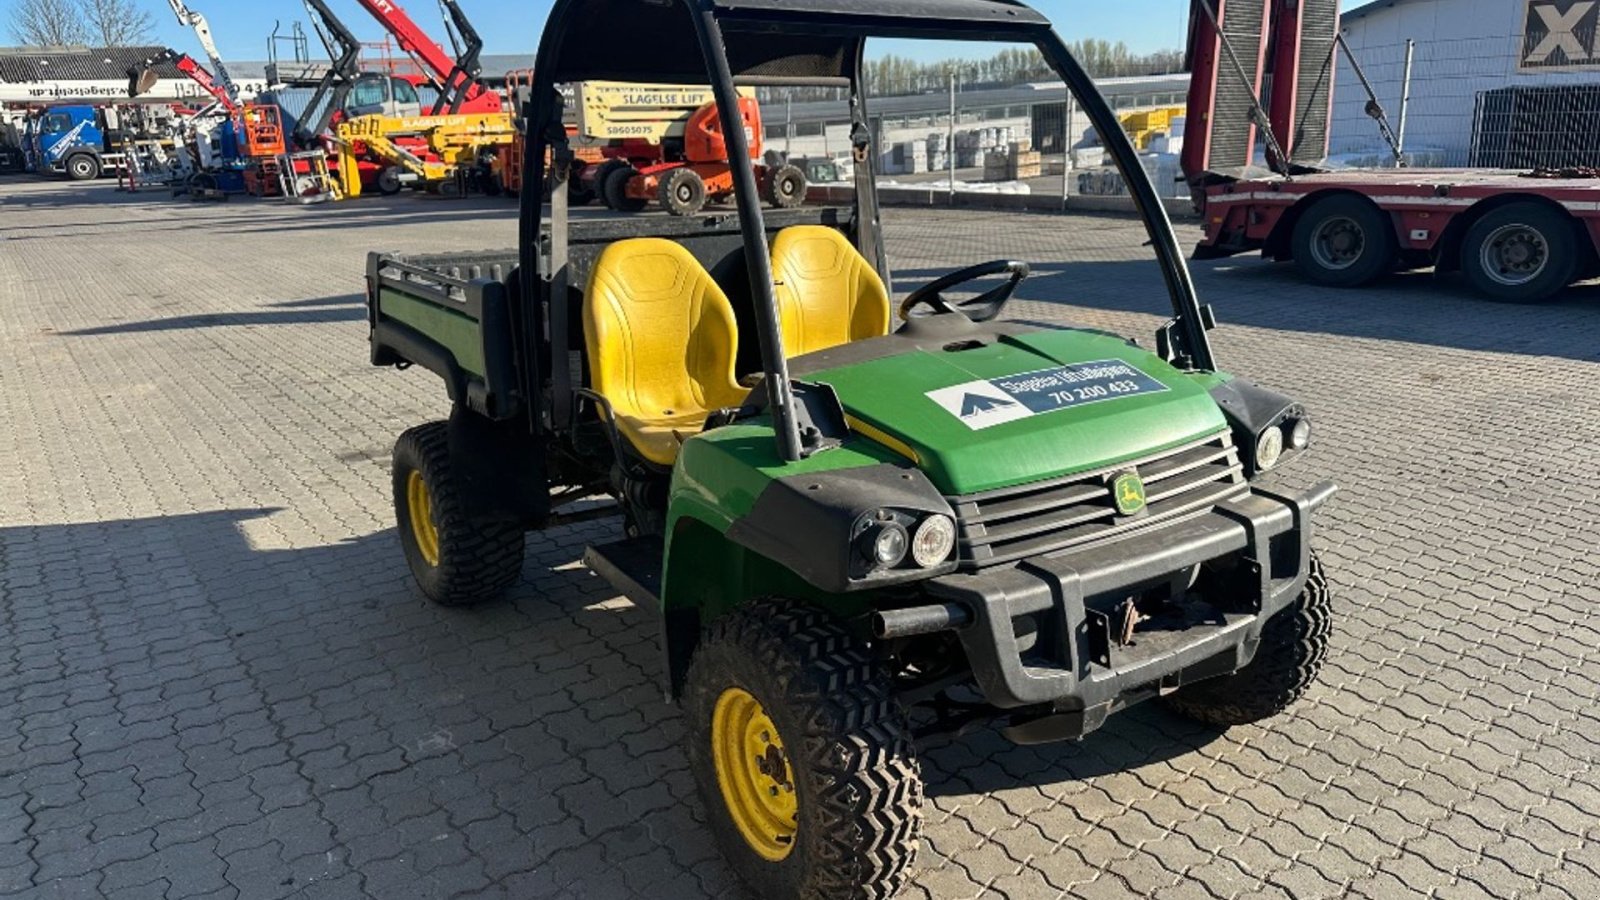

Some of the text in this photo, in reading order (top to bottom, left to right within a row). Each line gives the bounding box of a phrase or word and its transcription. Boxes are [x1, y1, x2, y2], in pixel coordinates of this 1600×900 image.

[623, 94, 705, 105] SLAGELSE LIFT
[1048, 380, 1140, 405] 70 200 433
